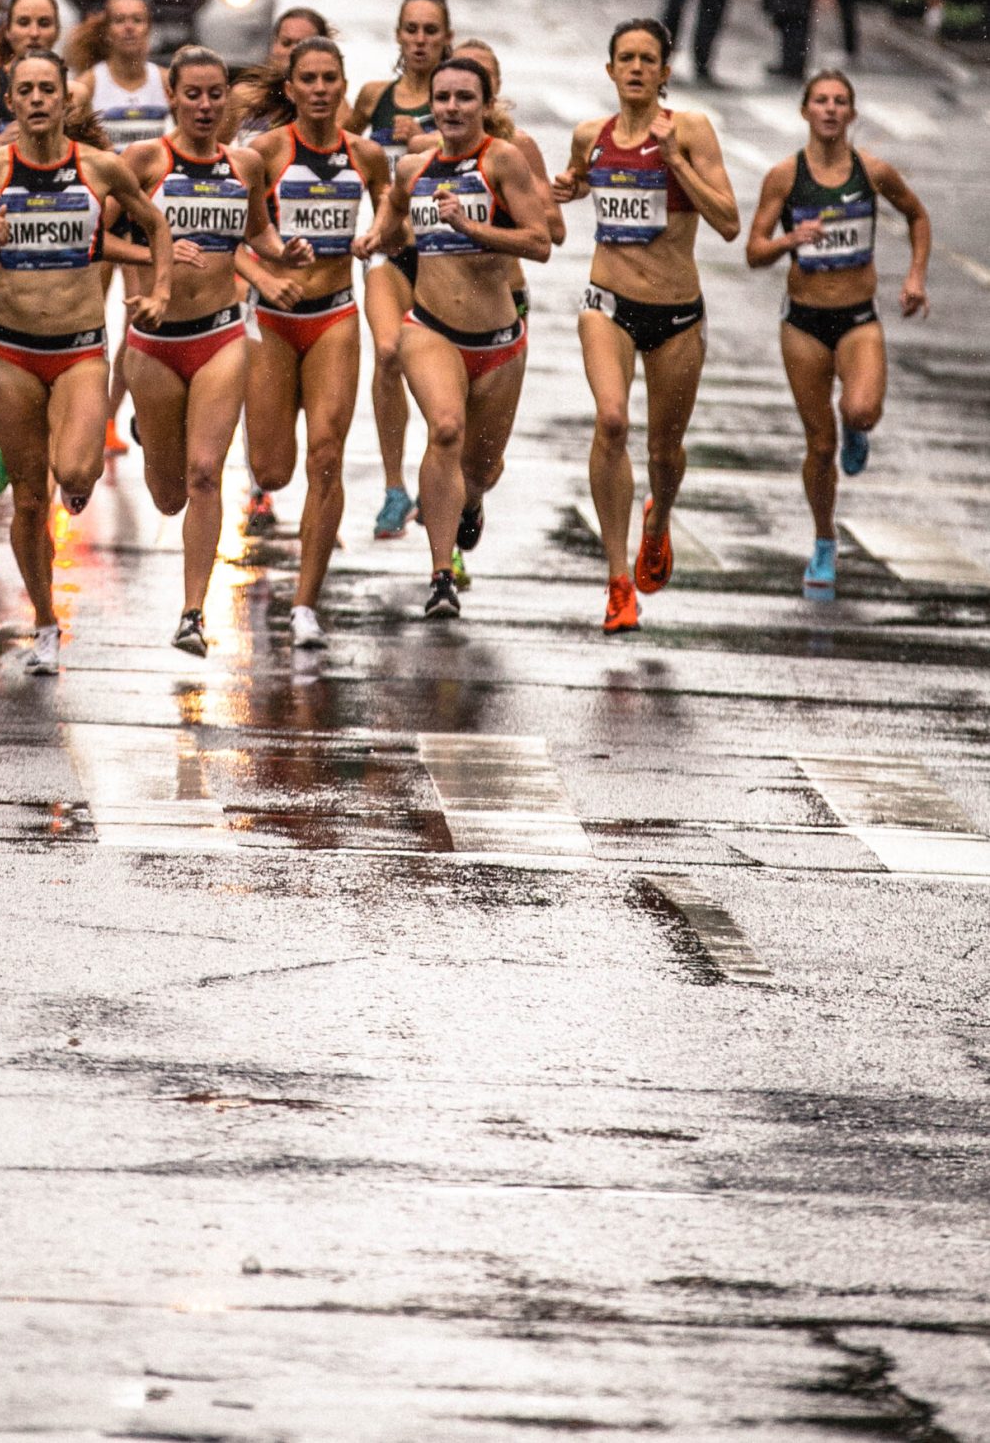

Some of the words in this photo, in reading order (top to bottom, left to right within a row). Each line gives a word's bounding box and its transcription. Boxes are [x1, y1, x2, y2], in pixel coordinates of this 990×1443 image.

[53, 168, 77, 182] NB
[165, 206, 248, 231] COURTNEY
[295, 208, 350, 229] MCGEE
[598, 196, 650, 220] GRACE
